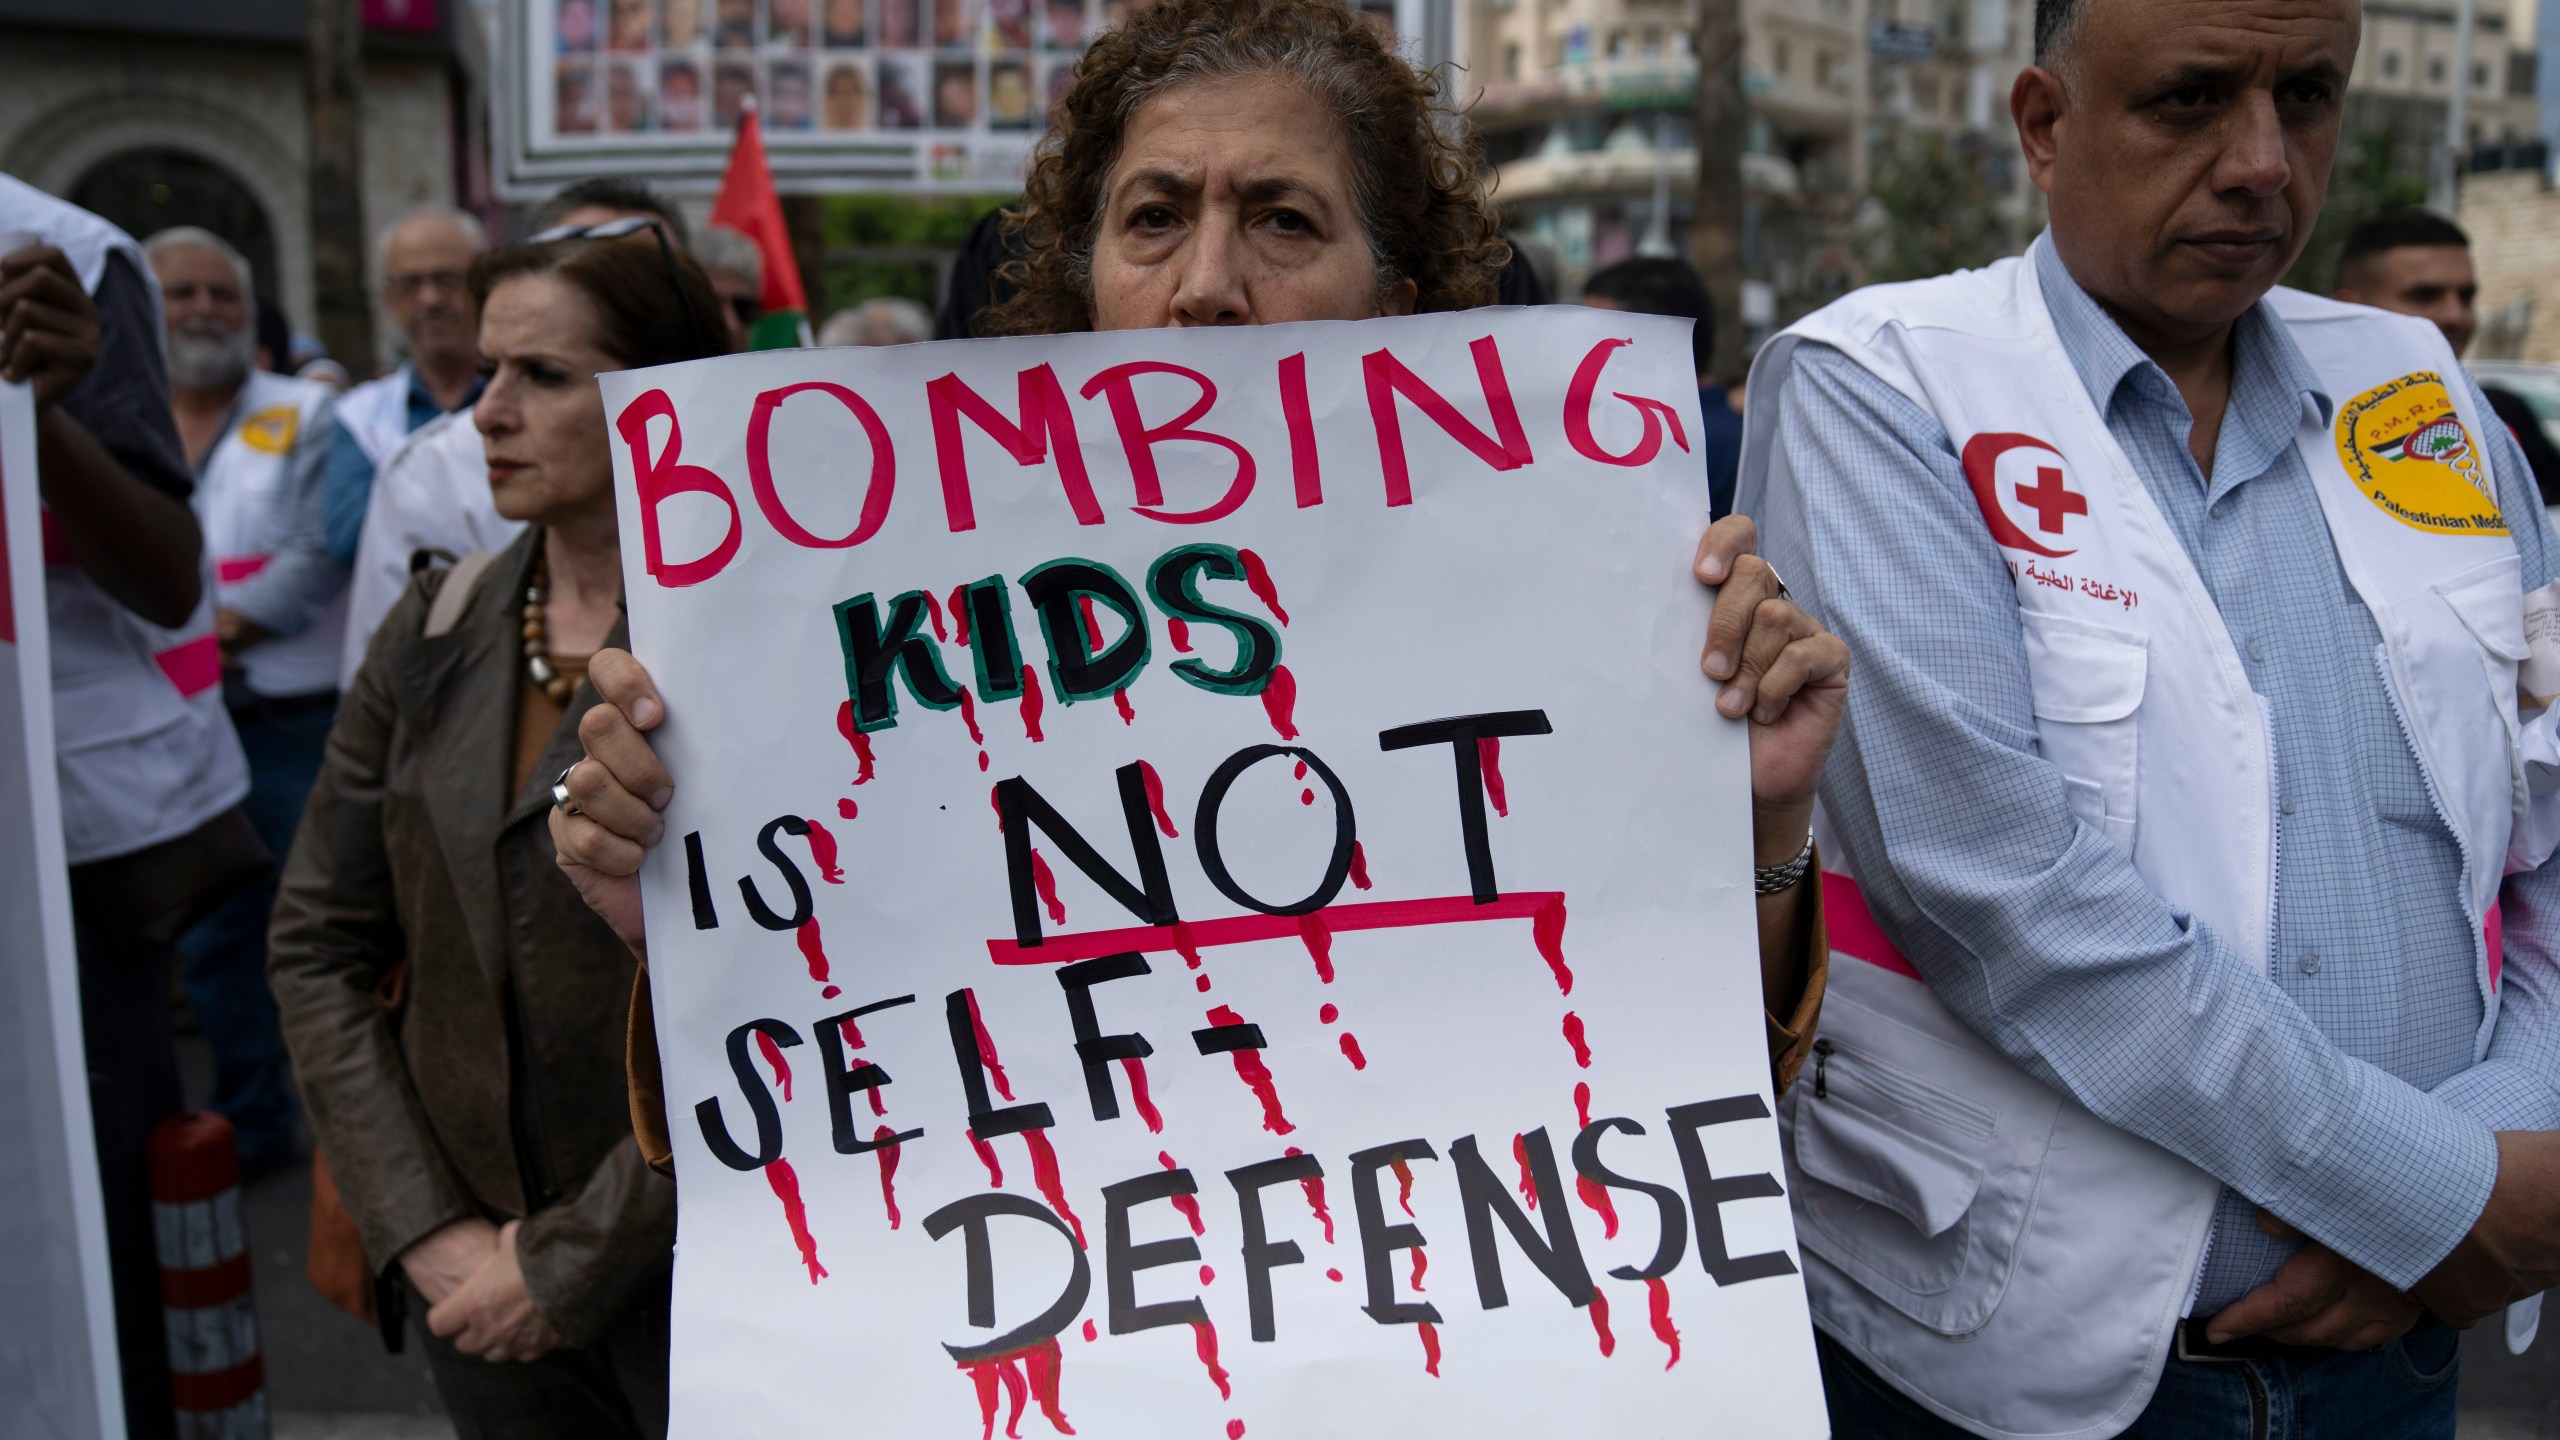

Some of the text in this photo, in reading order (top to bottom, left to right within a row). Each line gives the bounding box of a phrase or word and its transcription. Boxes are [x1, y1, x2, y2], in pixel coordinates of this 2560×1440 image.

[615, 333, 1692, 590] BOMBING
[2373, 489, 2471, 530] Palestinian
[832, 543, 1284, 735] KIDS
[2025, 558, 2075, 593] الطبية
[2081, 577, 2139, 611] الإغاثة
[683, 708, 1554, 949] IS NOT
[694, 950, 1269, 1172] SELF-
[922, 1093, 1799, 1362] DEFENSE
